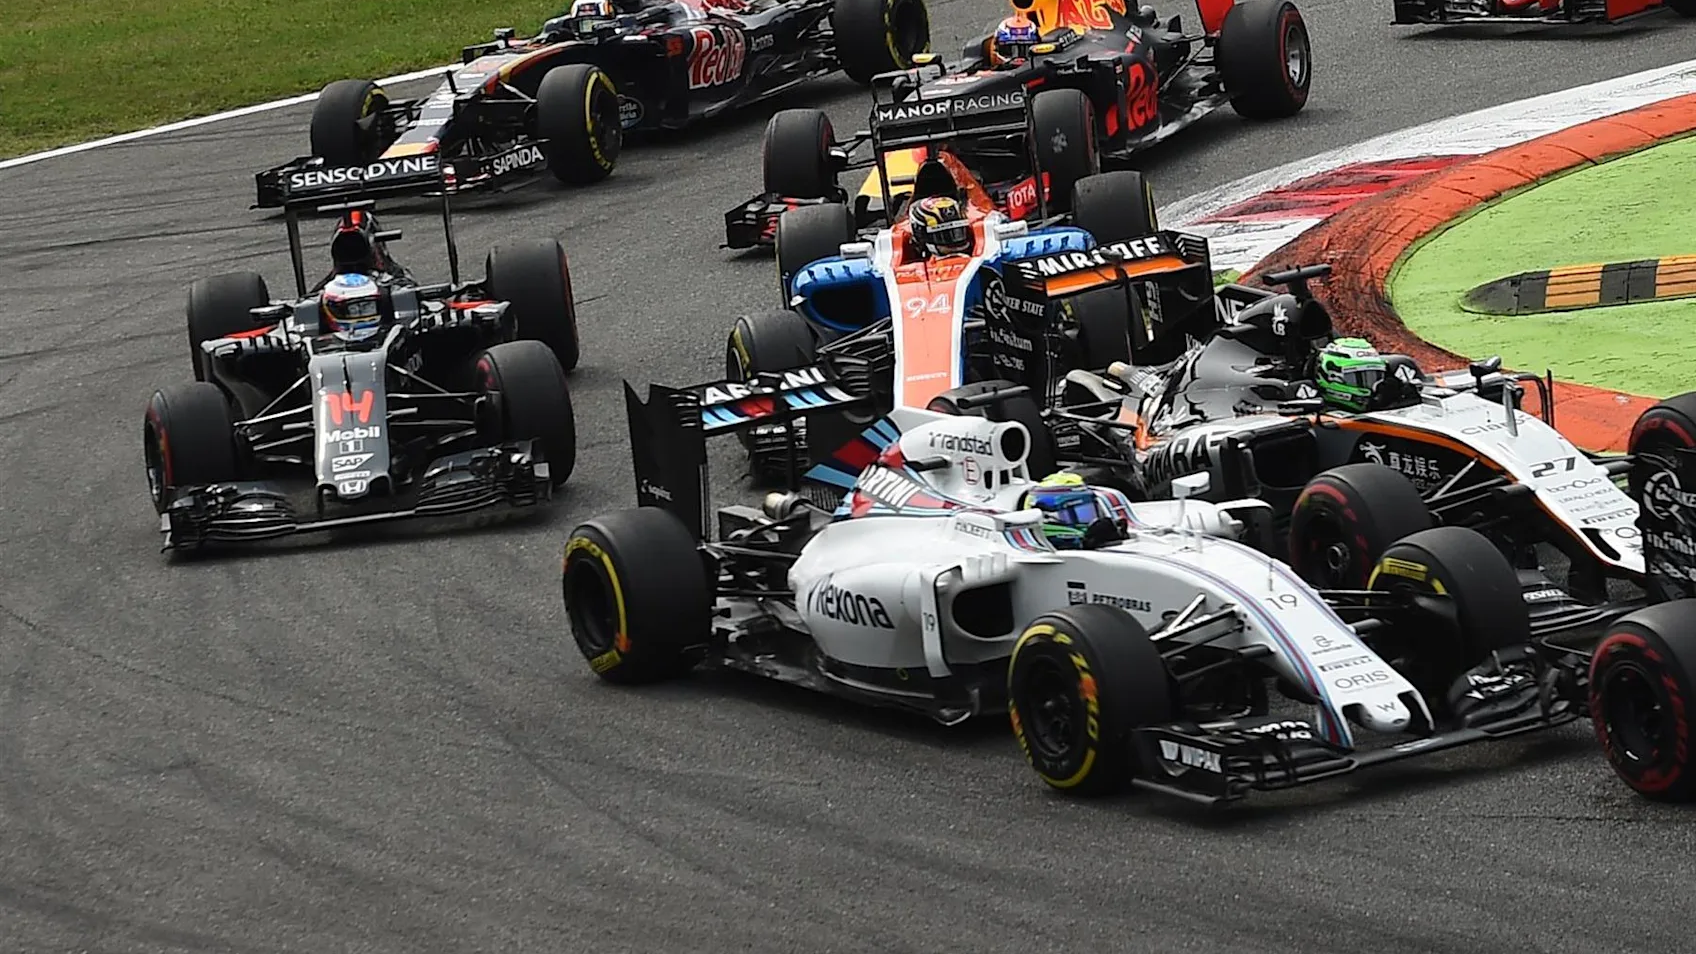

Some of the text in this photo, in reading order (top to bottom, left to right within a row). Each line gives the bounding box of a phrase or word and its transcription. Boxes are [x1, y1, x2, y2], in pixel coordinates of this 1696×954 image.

[689, 27, 727, 90] Red
[879, 91, 1024, 122] MANOR RACING
[290, 155, 437, 189] SENSODYNE
[493, 146, 545, 175] SAPINDA
[1009, 184, 1037, 209] TOTA
[906, 293, 952, 319] 94
[322, 389, 374, 425] 14
[325, 427, 380, 443] Mobil
[939, 433, 995, 457] randstad
[334, 456, 364, 467] SAP
[1531, 455, 1577, 479] 27
[816, 573, 896, 630] Rexona
[1265, 593, 1298, 611] 19
[1335, 669, 1391, 690] ORIS
